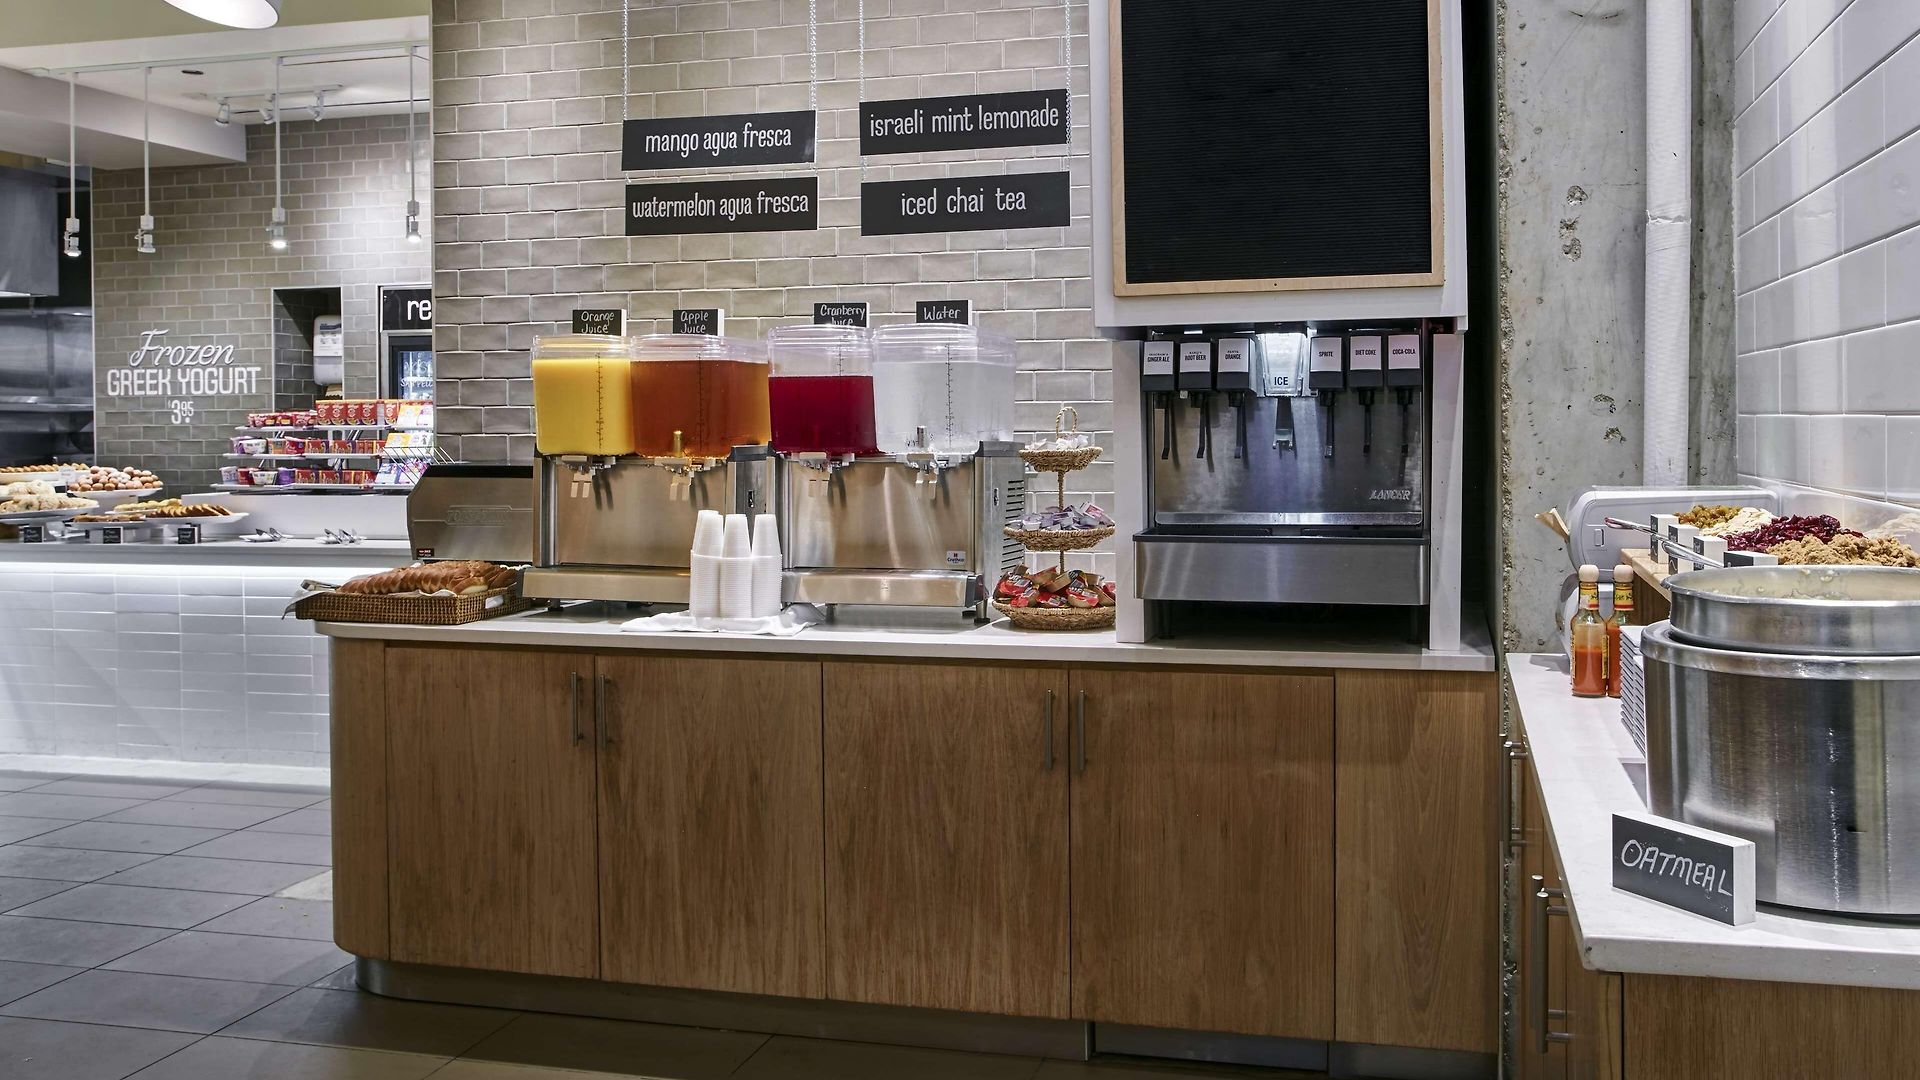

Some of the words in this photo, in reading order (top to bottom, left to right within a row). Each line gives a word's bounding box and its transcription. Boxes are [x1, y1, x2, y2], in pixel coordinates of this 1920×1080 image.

[870, 108, 924, 137] israeli
[931, 106, 974, 133] mint
[978, 97, 1059, 131] lemonade
[645, 133, 699, 159] mango
[703, 131, 738, 157] agua
[742, 121, 792, 148] fresca
[632, 192, 716, 218] watermelon
[719, 197, 753, 222] agua
[756, 190, 809, 215] fresca
[901, 187, 937, 216] iced
[946, 186, 984, 214] chai
[994, 187, 1027, 211] tea
[580, 311, 615, 326] Orange
[680, 310, 709, 326] Apple
[820, 304, 866, 320] Cranberry
[923, 305, 962, 321] Water
[581, 324, 609, 334] Juice
[680, 324, 706, 334] Juice
[129, 328, 235, 367] Frozen
[107, 368, 172, 396] GREEK
[177, 367, 262, 395] YOGURT
[1274, 376, 1289, 386] ICE
[1620, 839, 1733, 897] OATMEAL
